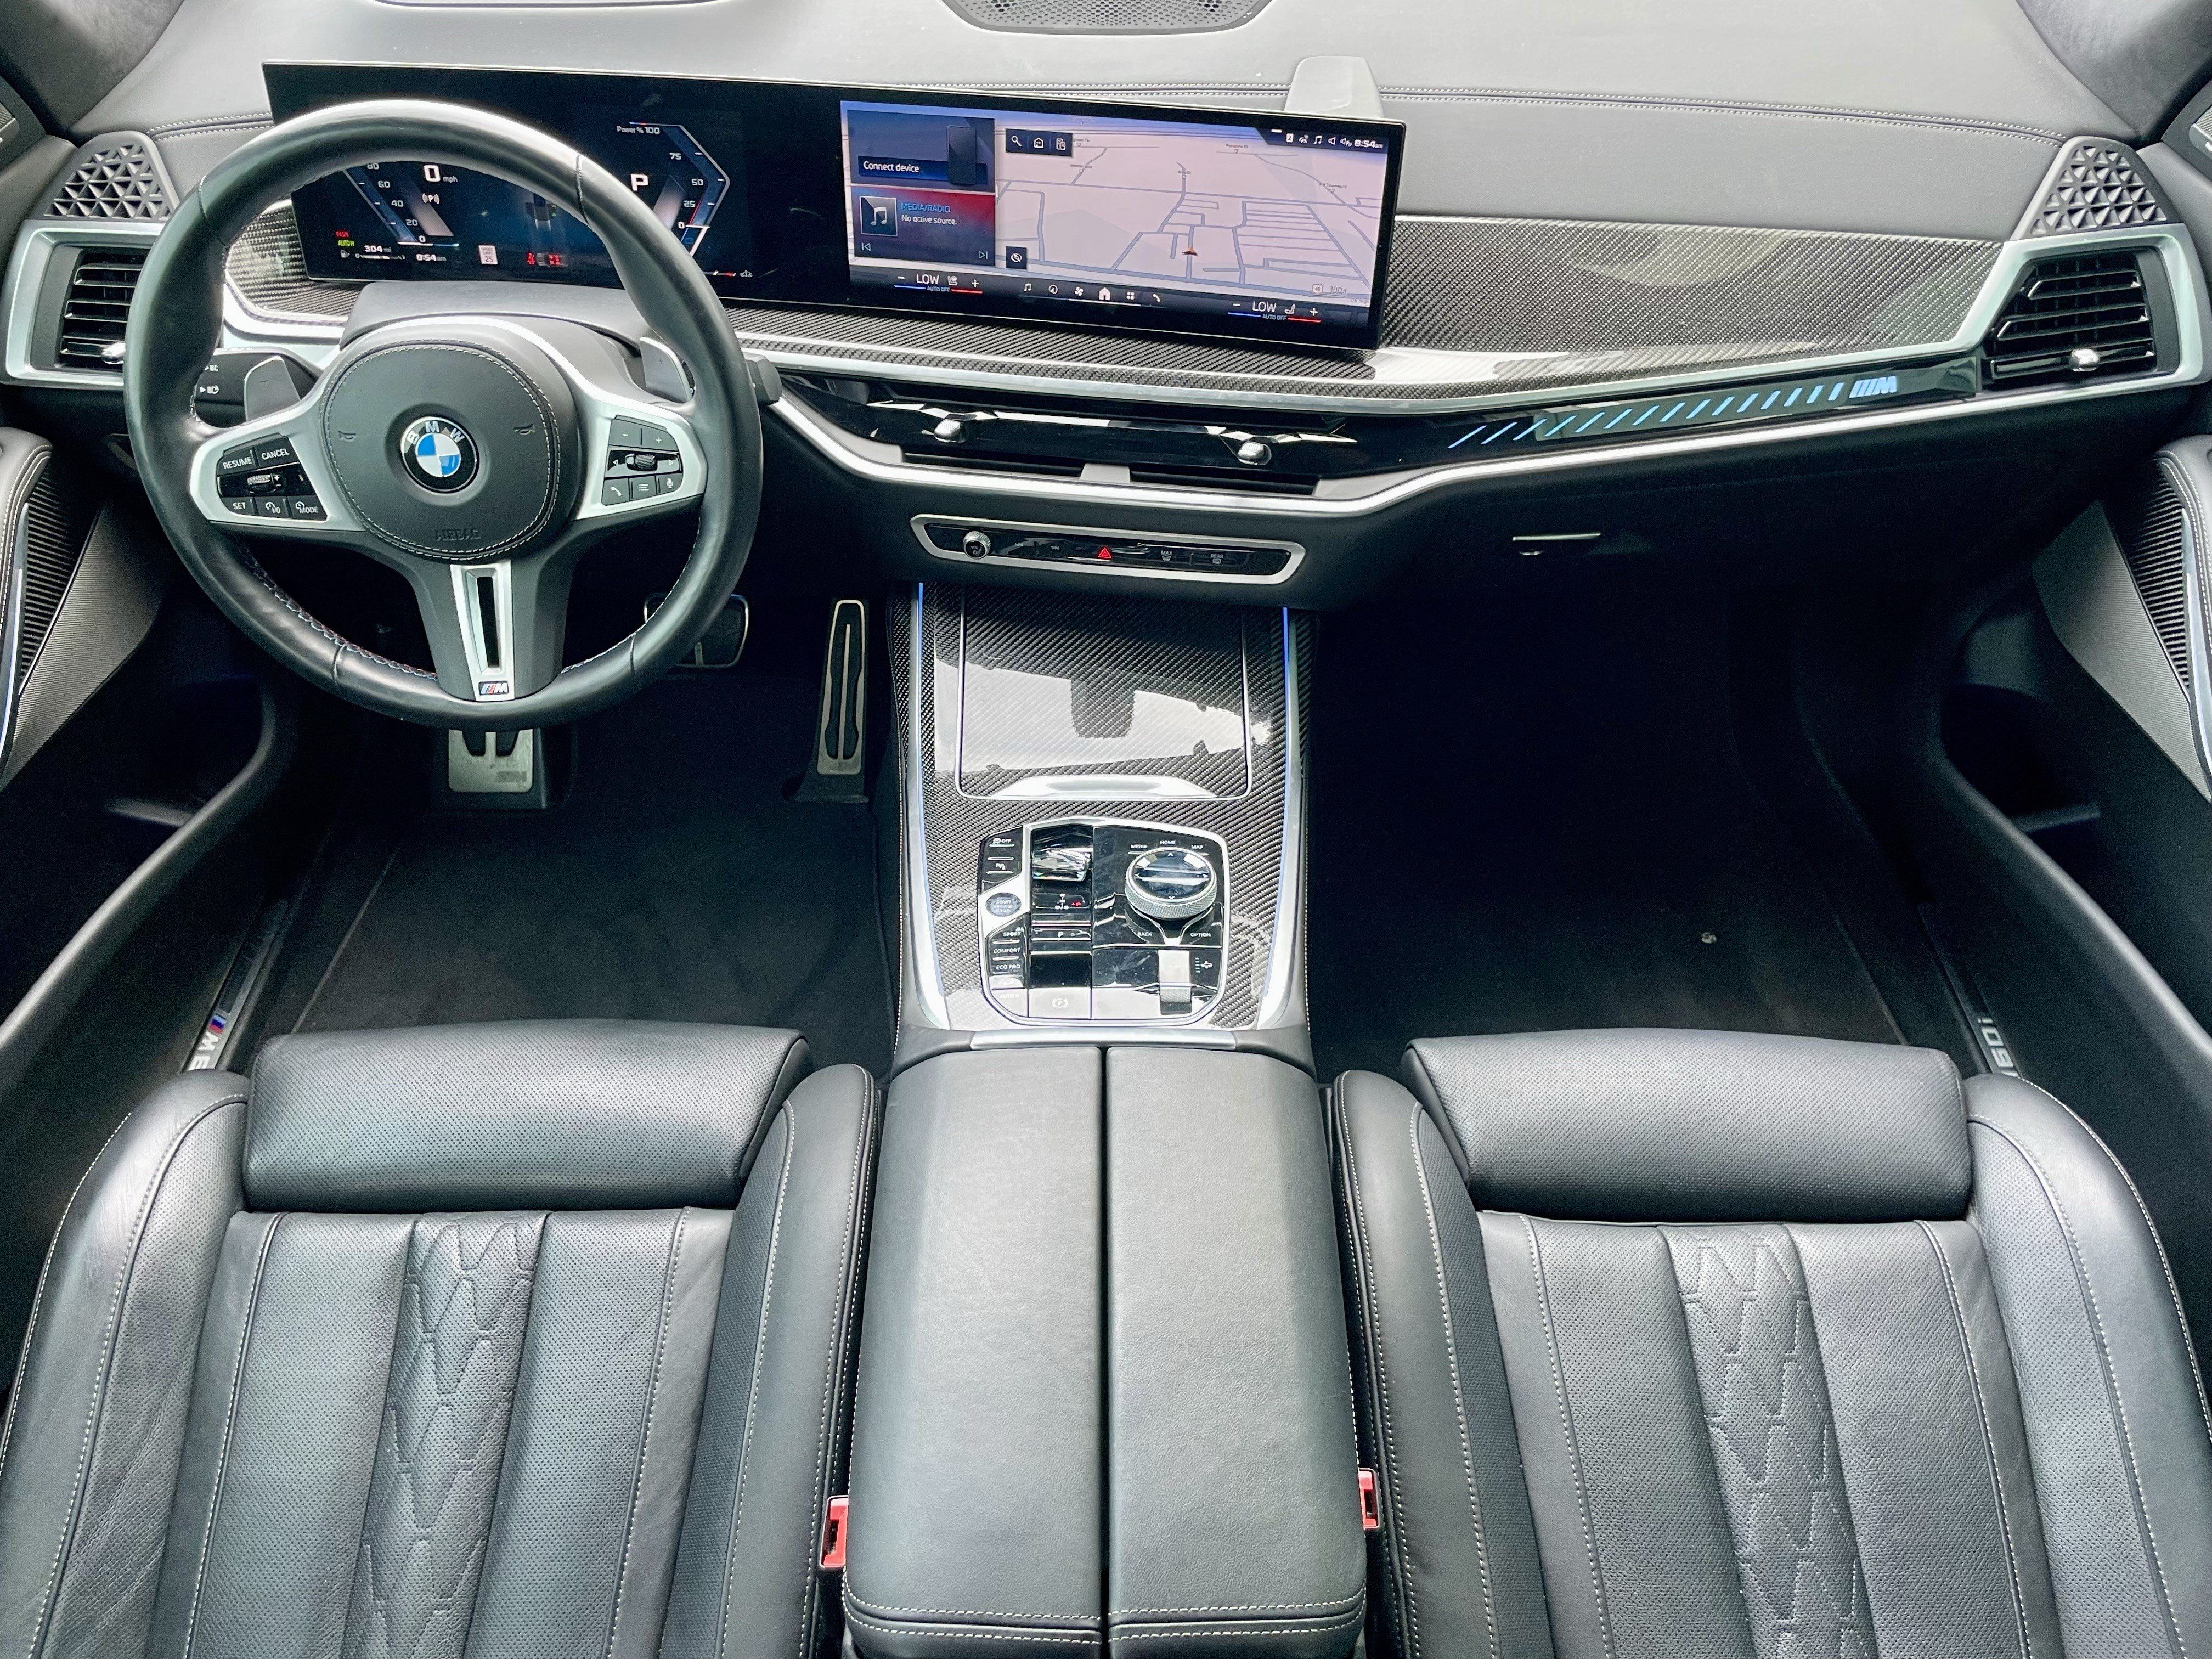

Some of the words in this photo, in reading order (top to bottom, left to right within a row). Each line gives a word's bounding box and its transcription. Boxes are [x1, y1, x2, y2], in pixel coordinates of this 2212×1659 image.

[424, 165, 441, 182] 0
[864, 161, 894, 171] Connect
[895, 163, 919, 173] device
[630, 173, 649, 191] P
[901, 202, 951, 213] MEDIA/RADIO
[934, 217, 958, 225] source.
[916, 274, 940, 285] LOW
[1252, 301, 1277, 313] LOW
[406, 420, 465, 445] BMW
[223, 456, 252, 470] RESUME
[261, 448, 290, 460] CANCEL
[1977, 1018, 2018, 1077] 60i
